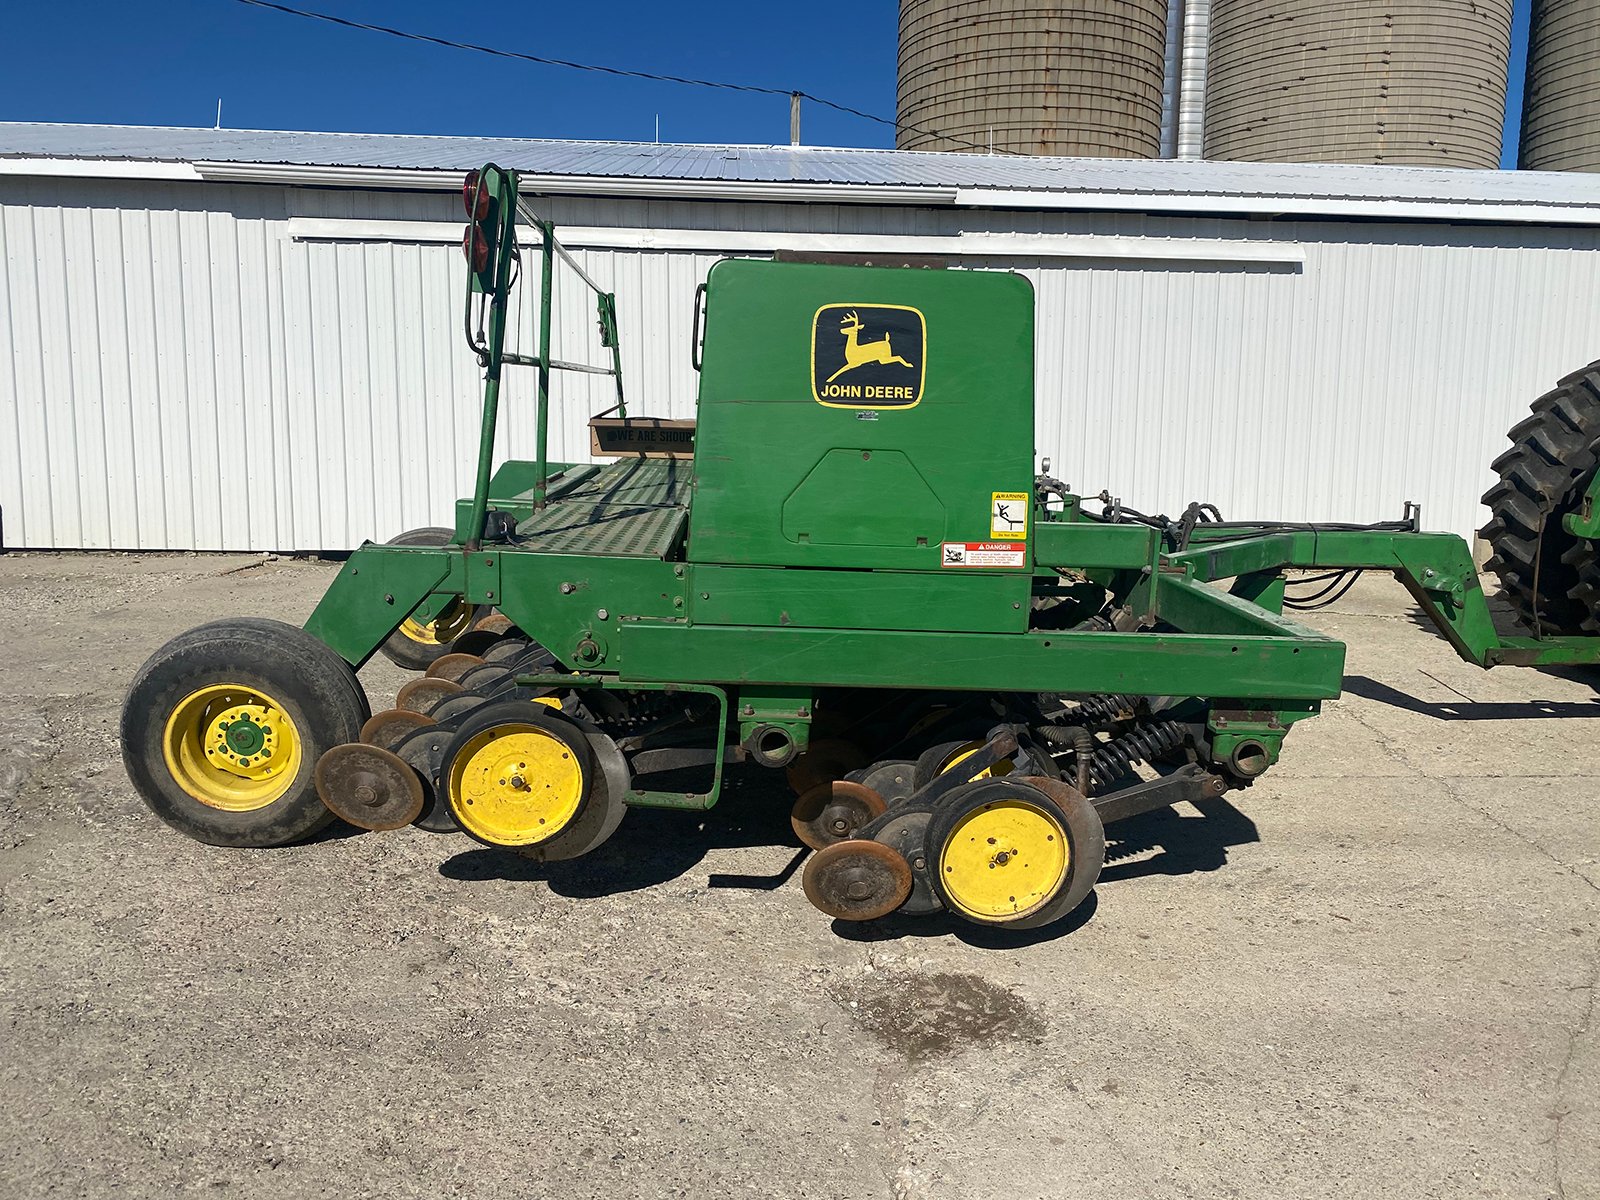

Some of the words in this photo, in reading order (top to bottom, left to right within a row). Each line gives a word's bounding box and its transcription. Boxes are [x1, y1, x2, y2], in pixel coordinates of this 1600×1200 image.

[821, 385, 861, 398] JOHN
[865, 386, 913, 399] DEERE
[617, 430, 634, 441] WE
[637, 430, 656, 442] ARE
